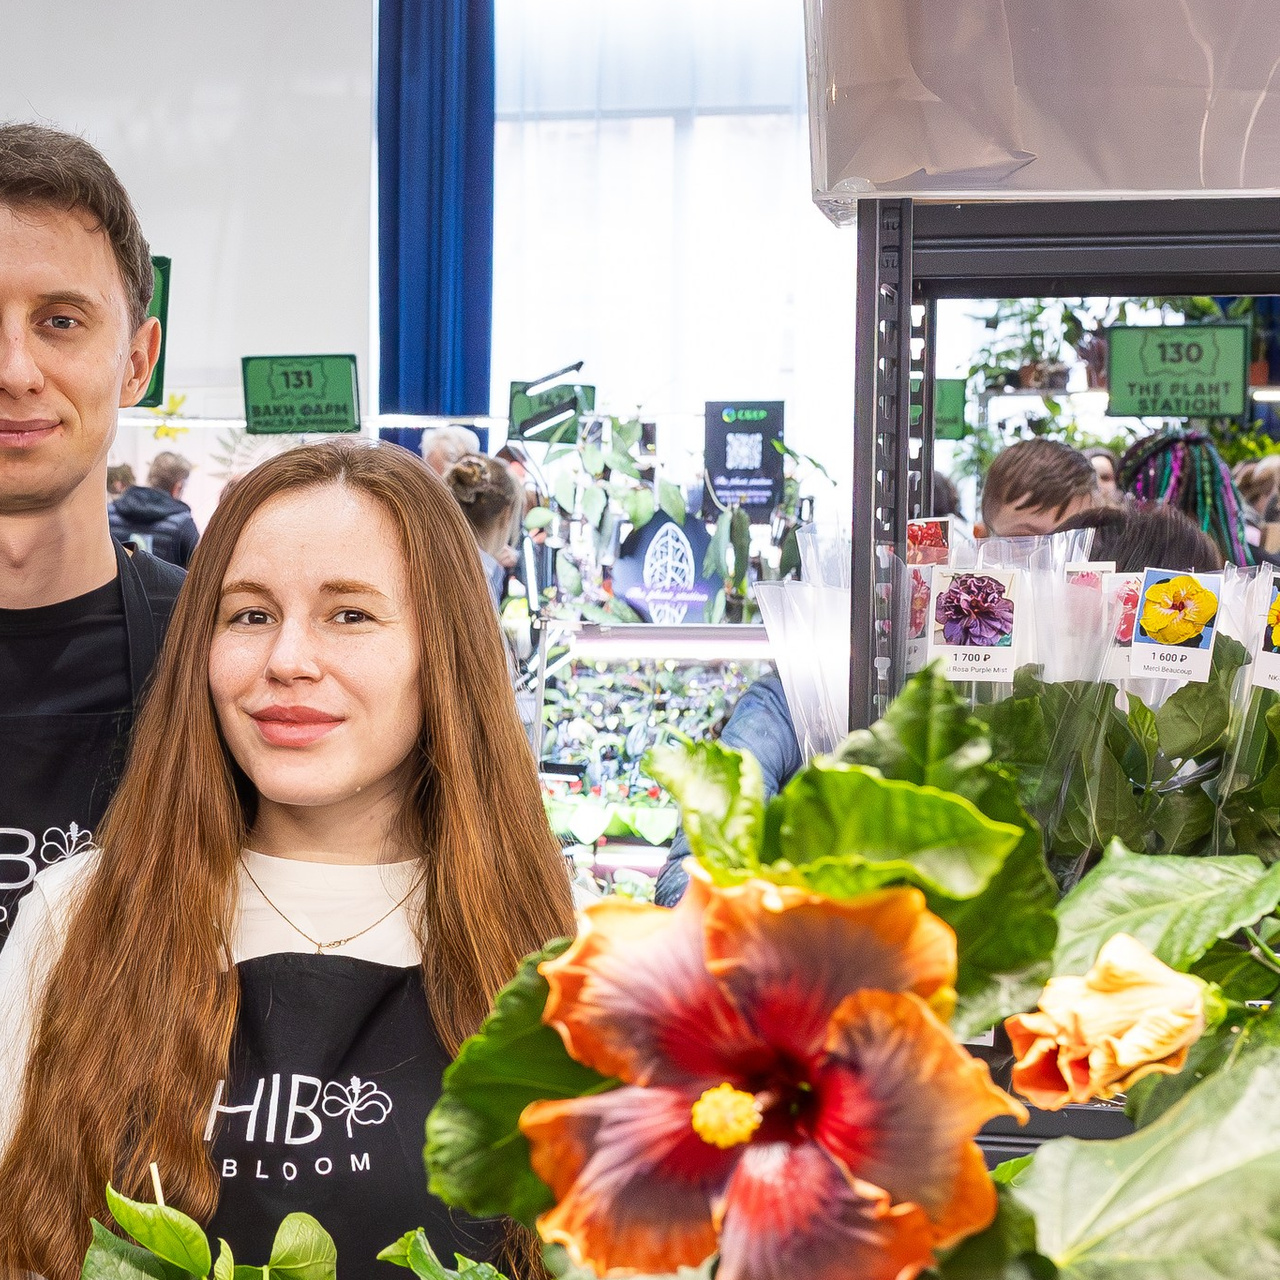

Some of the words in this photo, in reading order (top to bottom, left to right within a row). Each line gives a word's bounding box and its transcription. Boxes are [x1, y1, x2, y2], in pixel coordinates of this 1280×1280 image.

[1158, 342, 1203, 364] 130
[281, 370, 313, 389] 131
[1127, 381, 1161, 397] THE
[1169, 381, 1231, 397] PLANT
[1138, 398, 1221, 414] STATION
[962, 653, 980, 662] 700
[1160, 652, 1177, 663] 600
[970, 666, 992, 674] Purple
[1143, 664, 1160, 673] Merci
[1161, 665, 1193, 676] Beaucoup
[222, 1152, 371, 1181] BLOOM
